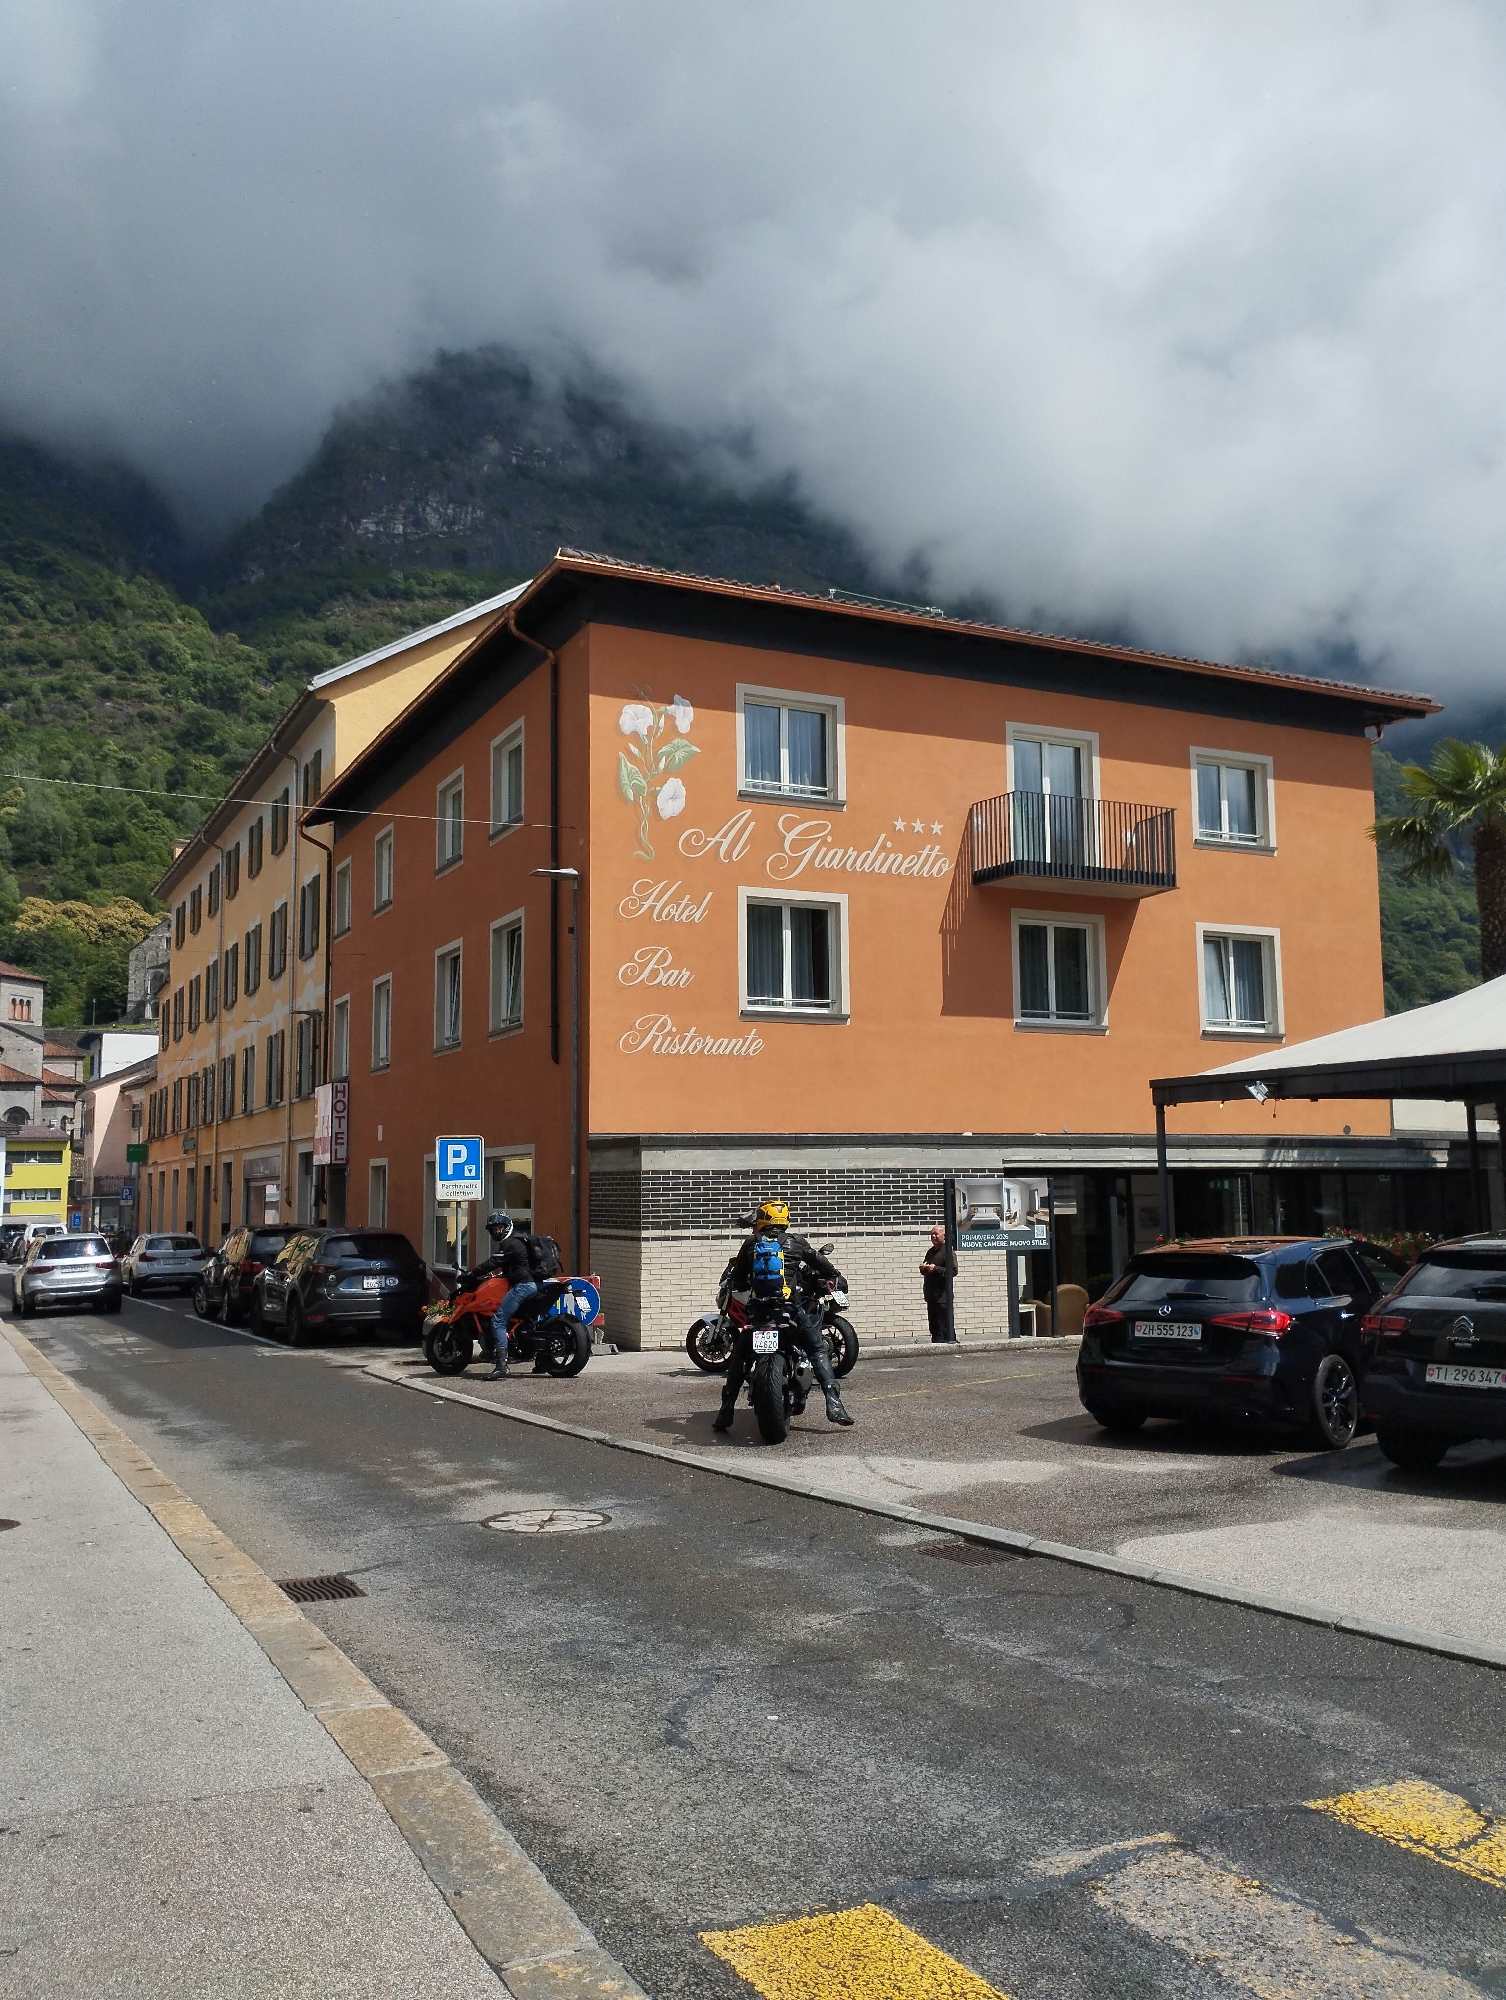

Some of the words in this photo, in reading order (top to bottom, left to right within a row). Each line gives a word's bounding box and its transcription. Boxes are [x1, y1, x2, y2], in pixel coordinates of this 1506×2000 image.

[678, 808, 756, 863] Al
[766, 813, 955, 881] Giardinetto
[618, 878, 714, 924] Hotel
[617, 945, 696, 988] Bar
[618, 1013, 766, 1057] Ristorante
[333, 1084, 347, 1162] HOTEL
[447, 1144, 468, 1175] P
